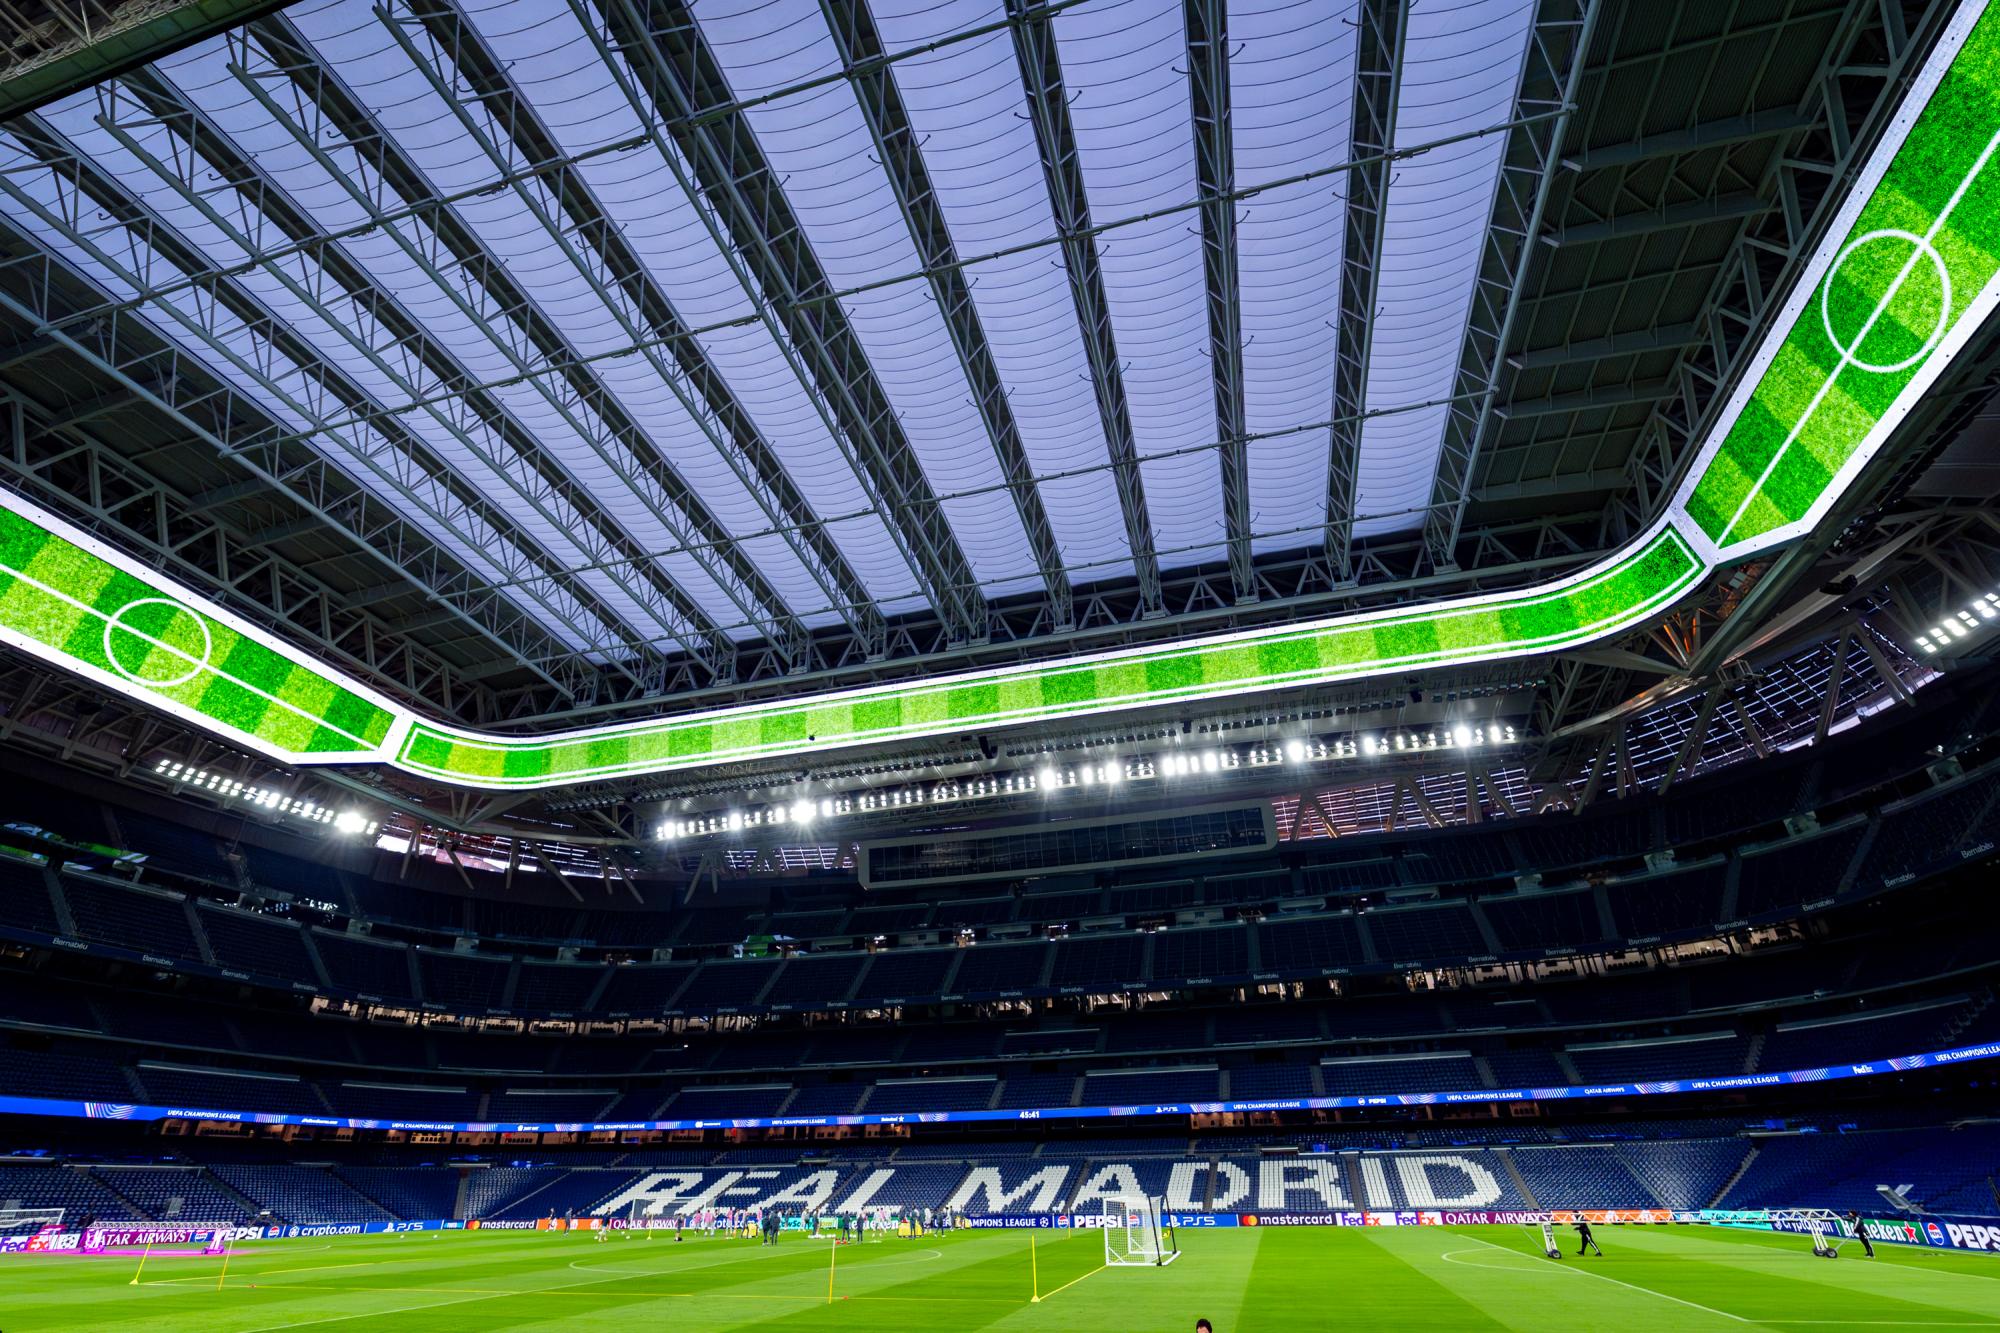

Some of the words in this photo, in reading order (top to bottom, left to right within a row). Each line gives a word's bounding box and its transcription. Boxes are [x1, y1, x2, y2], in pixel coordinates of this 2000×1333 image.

[1934, 1053, 1953, 1062] UEFA
[1953, 1047, 1989, 1060] CHAMPIONS
[1711, 1078, 1752, 1087] CHAMPIONS
[1752, 1075, 1780, 1083] LEAGUE
[1019, 1110, 1040, 1119] 45:41
[590, 1168, 902, 1216] REAL
[943, 1156, 1502, 1214] MADRID
[481, 1220, 535, 1229] mastercard
[613, 1219, 643, 1229] QAAR
[645, 1219, 680, 1229] AIRWAY
[1005, 1218, 1037, 1227] LEAGUE
[1074, 1215, 1122, 1228] PEPSI
[1182, 1216, 1216, 1226] PS5
[1260, 1214, 1334, 1226] mastercard
[1341, 1212, 1380, 1226] FedEx
[1394, 1211, 1436, 1226] FedEx
[1445, 1212, 1489, 1225] QATAR
[301, 1224, 361, 1236] crypto.com
[396, 1222, 424, 1231] PS5
[1840, 1219, 1906, 1242] Heneken
[0, 1236, 49, 1251] FedEx
[133, 1231, 187, 1244] AIRWAYS
